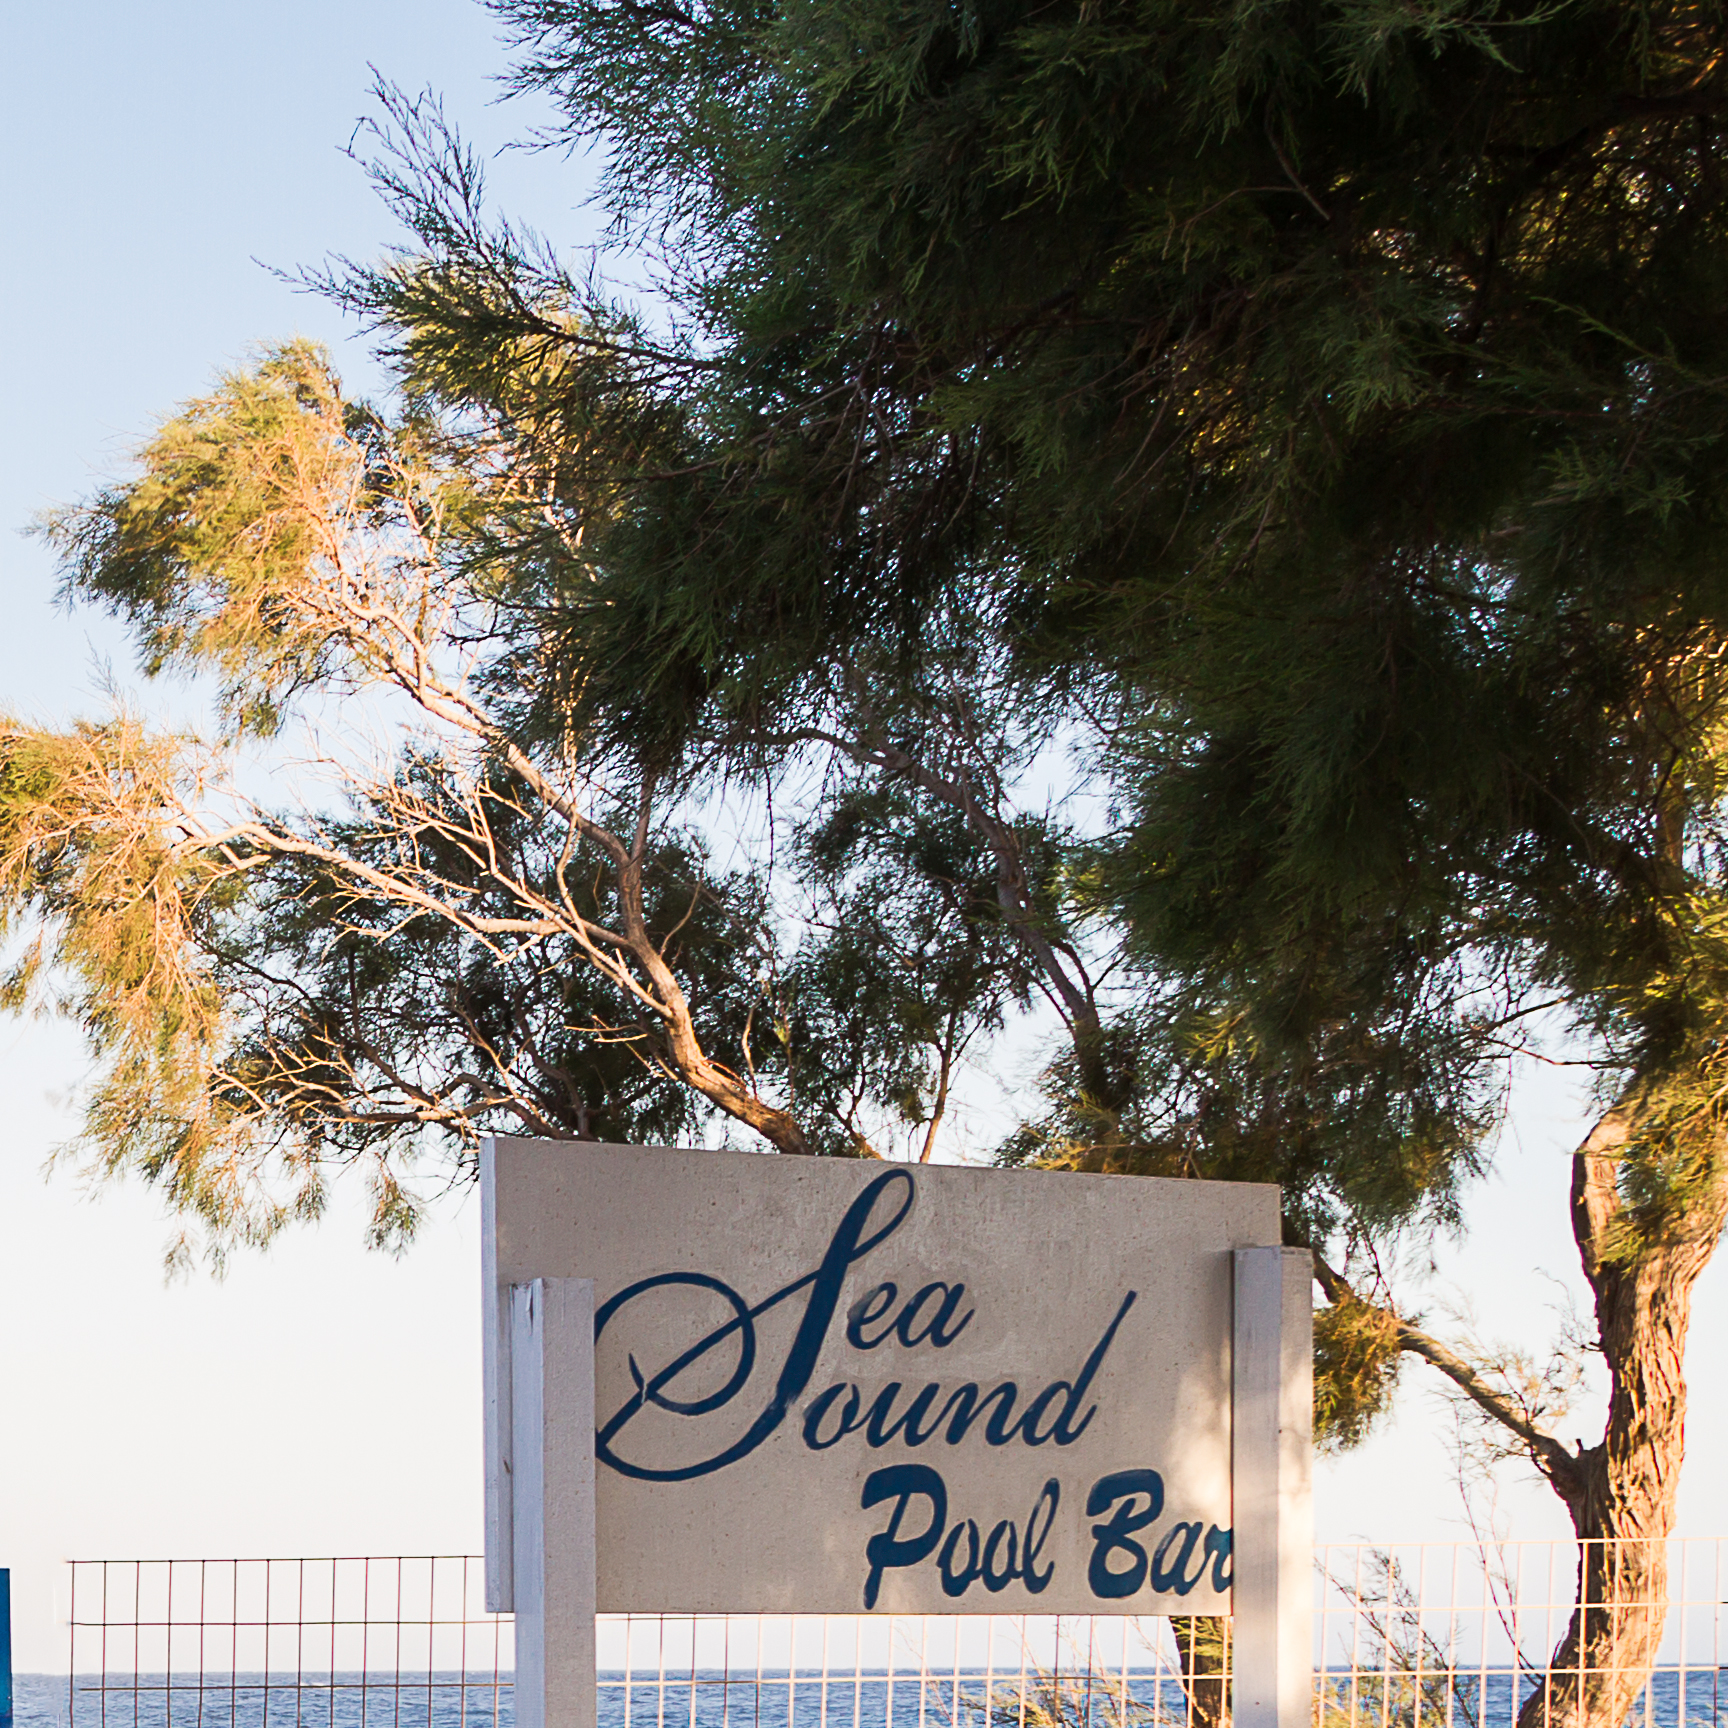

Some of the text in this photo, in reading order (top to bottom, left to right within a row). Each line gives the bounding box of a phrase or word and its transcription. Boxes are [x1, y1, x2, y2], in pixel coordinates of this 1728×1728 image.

[595, 1168, 975, 1482] Sea
[861, 1463, 1232, 1609] Pool Bar
